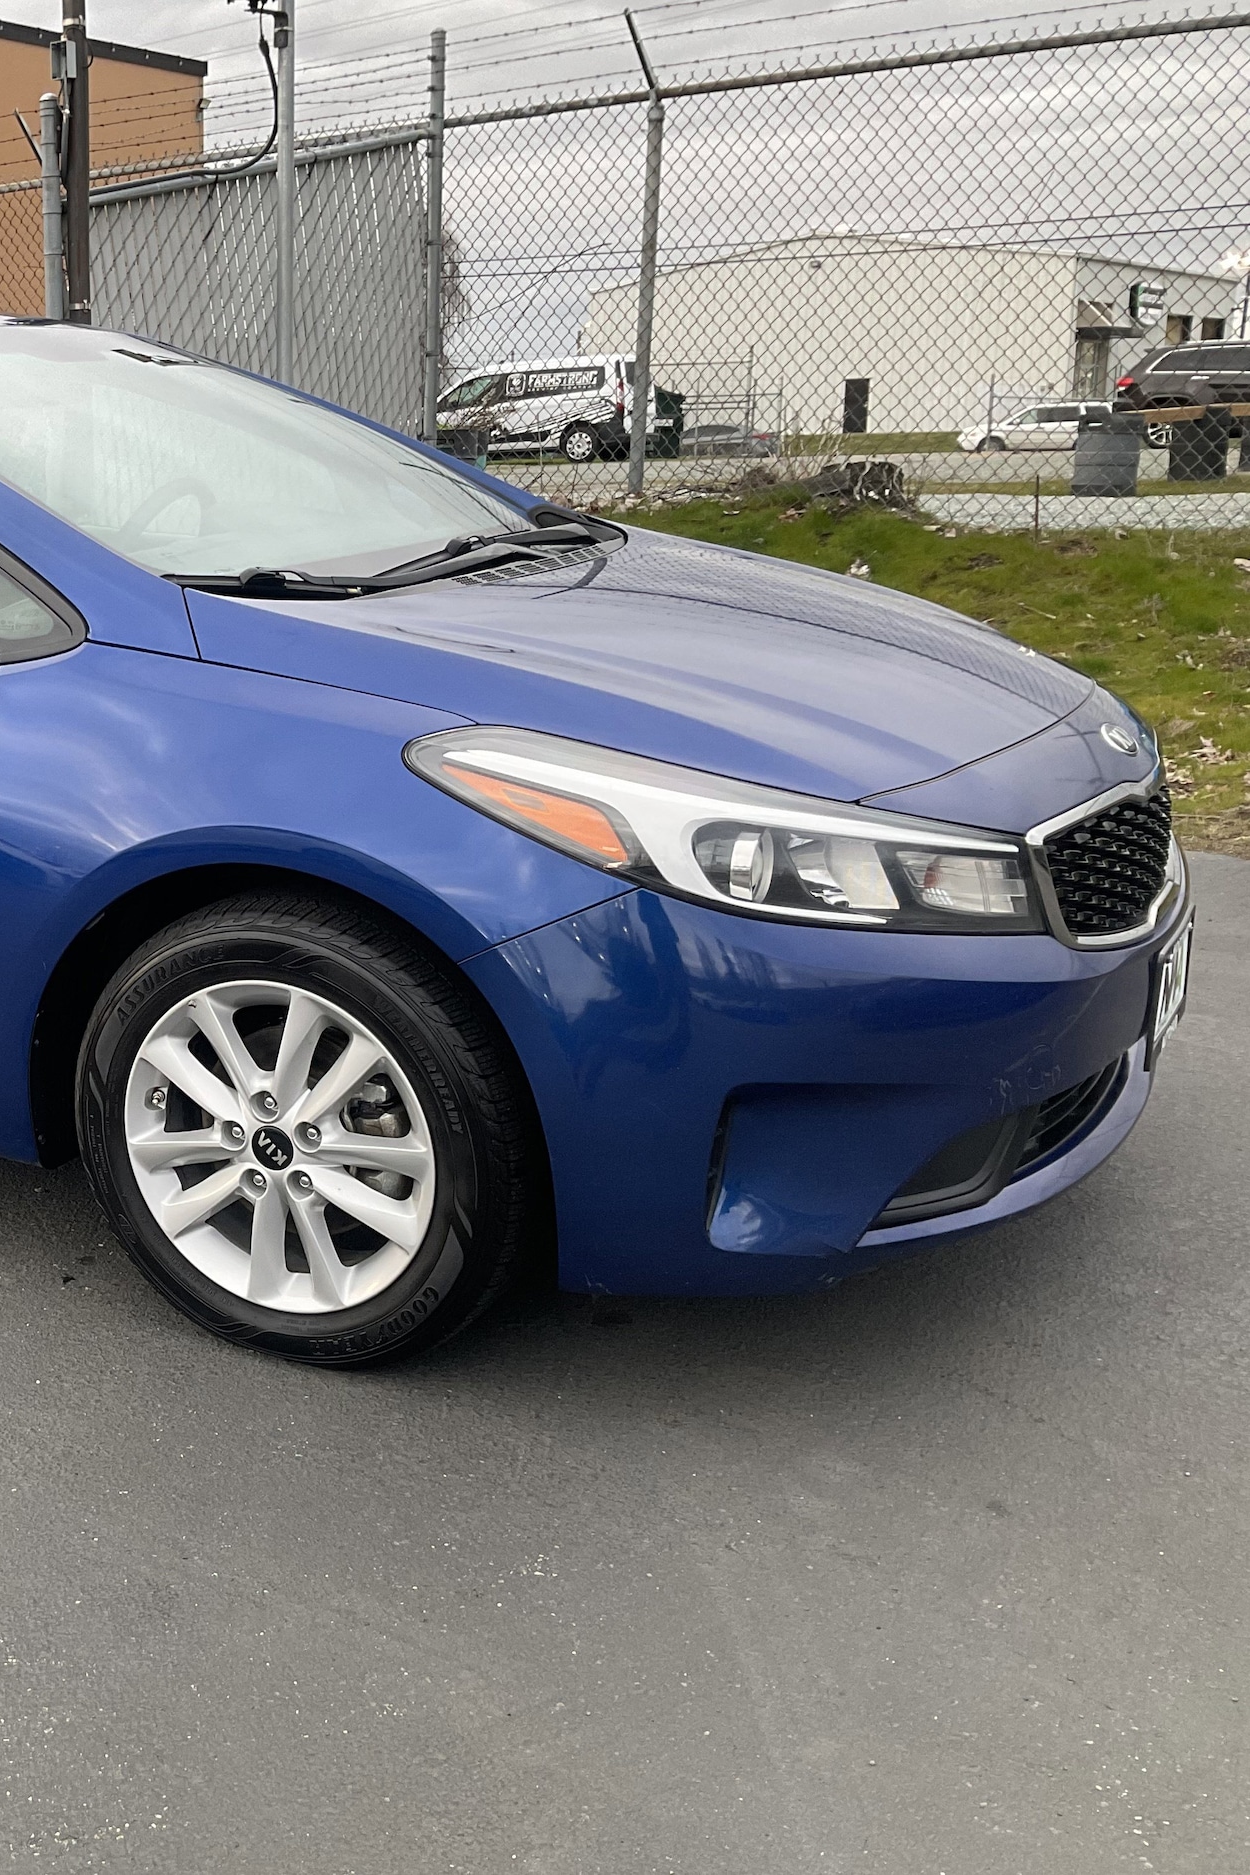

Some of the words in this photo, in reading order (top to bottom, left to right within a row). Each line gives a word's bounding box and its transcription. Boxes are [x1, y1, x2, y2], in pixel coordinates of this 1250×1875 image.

[116, 943, 225, 1027] ASSURANCE
[257, 1130, 288, 1167] KIA
[308, 1286, 440, 1356] GOODYEAR
